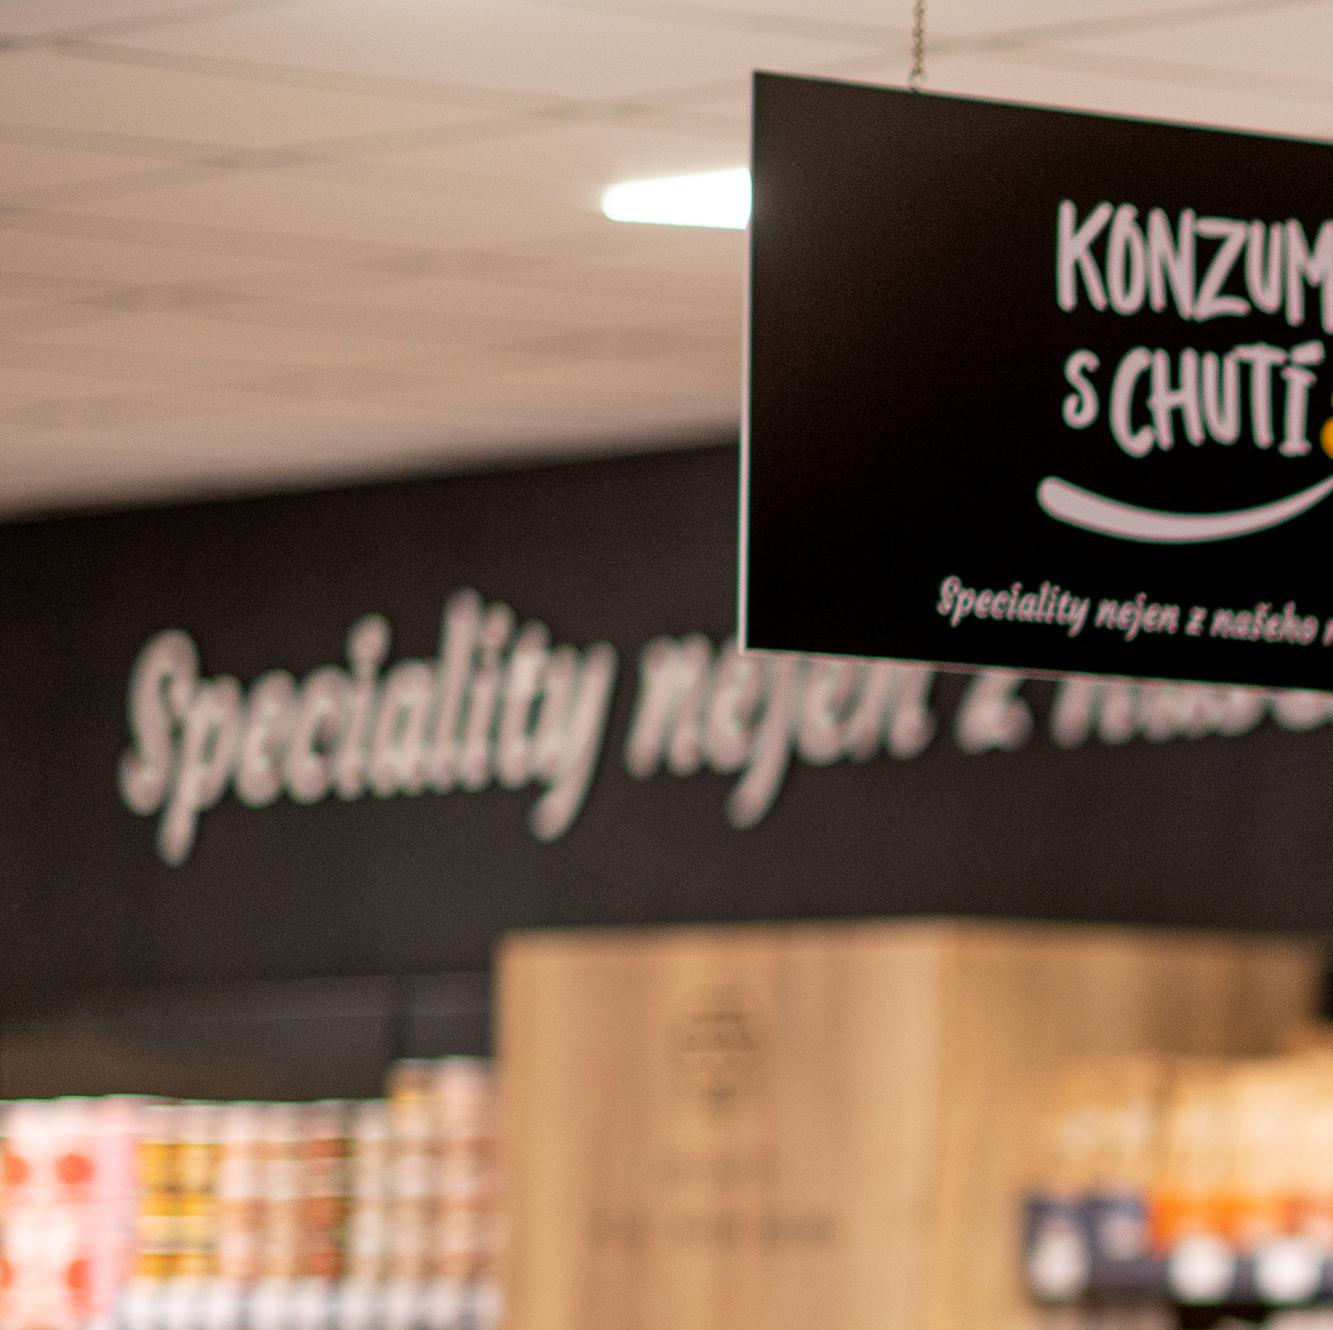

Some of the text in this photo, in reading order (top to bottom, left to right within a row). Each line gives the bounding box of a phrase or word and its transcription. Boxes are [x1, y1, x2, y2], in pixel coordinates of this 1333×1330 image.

[1109, 340, 1325, 457] CHUTÍ
[936, 575, 1090, 637] Speciality
[1095, 591, 1180, 642] nejen
[1184, 605, 1208, 637] z
[1210, 600, 1318, 646] našeho
[119, 588, 617, 866] Speciality
